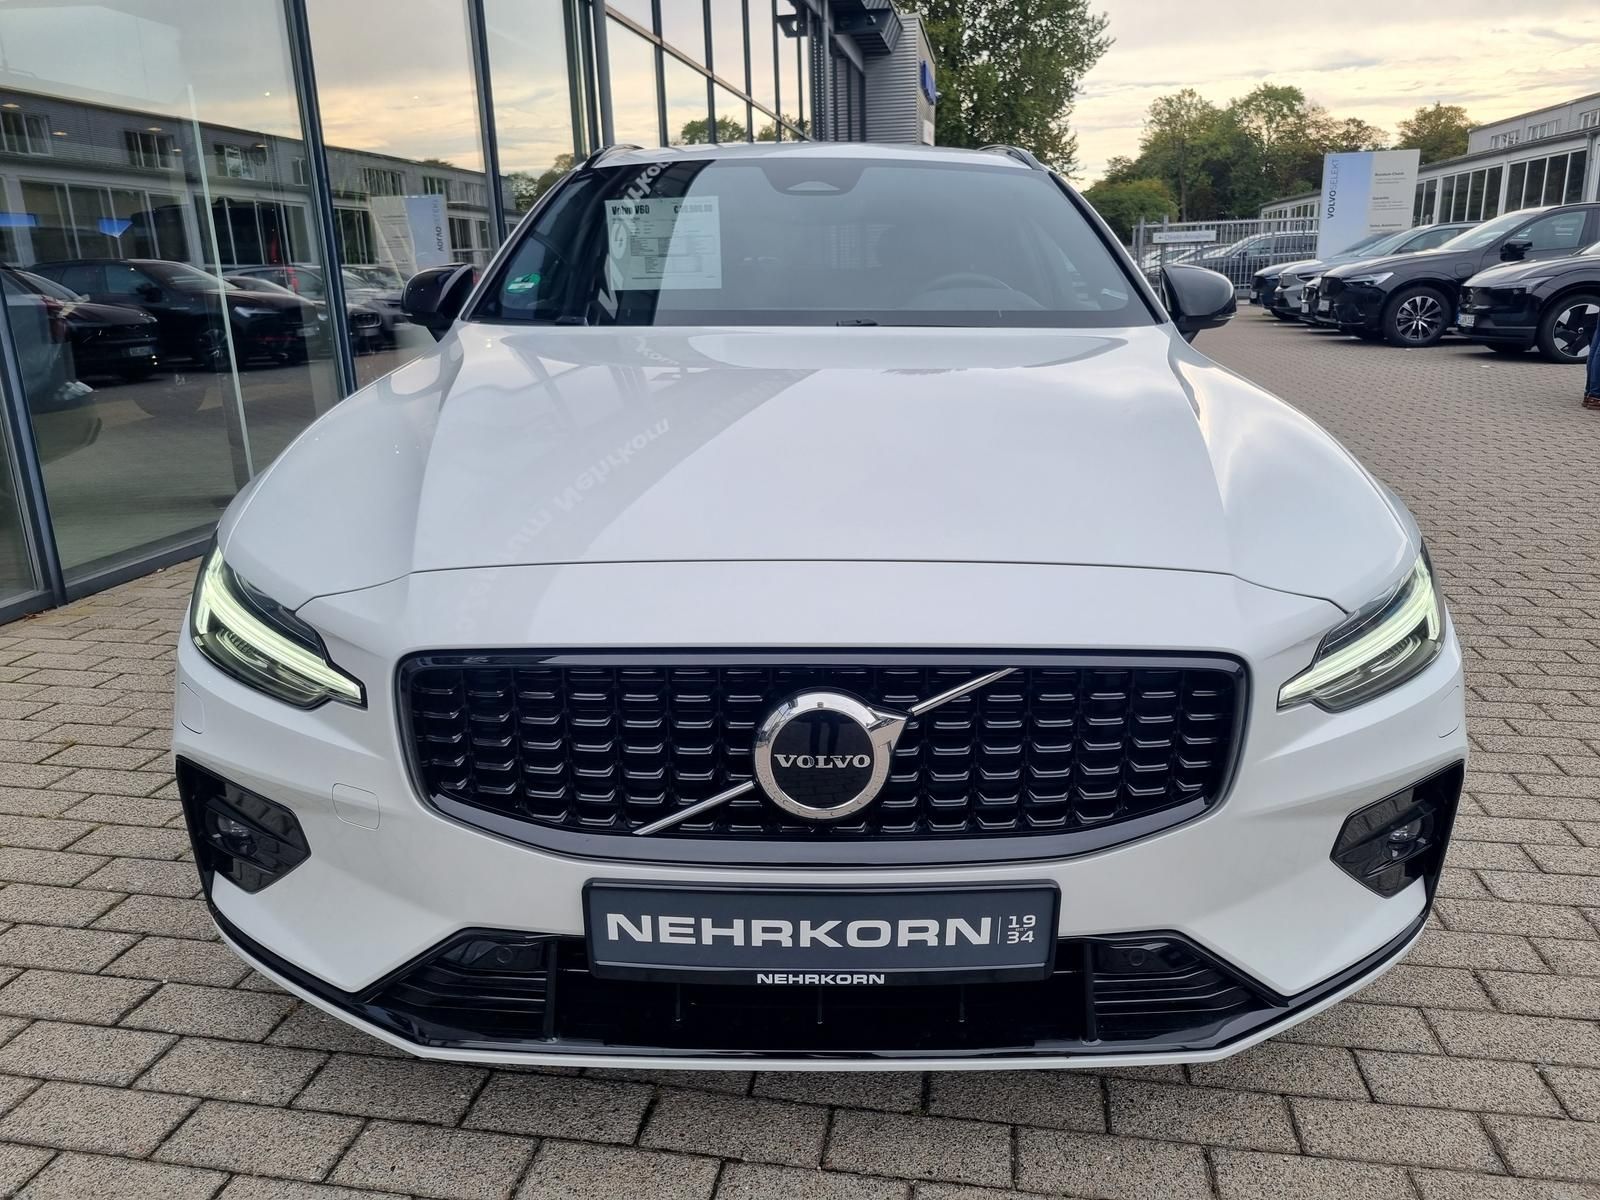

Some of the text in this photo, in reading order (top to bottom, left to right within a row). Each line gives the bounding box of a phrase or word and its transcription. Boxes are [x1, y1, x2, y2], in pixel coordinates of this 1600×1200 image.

[635, 204, 650, 215] V60
[774, 753, 871, 769] VOLVO
[1008, 914, 1036, 928] 19
[605, 912, 992, 949] NEHRKORN
[1006, 930, 1034, 944] 34
[756, 972, 886, 985] NEHRKORN
